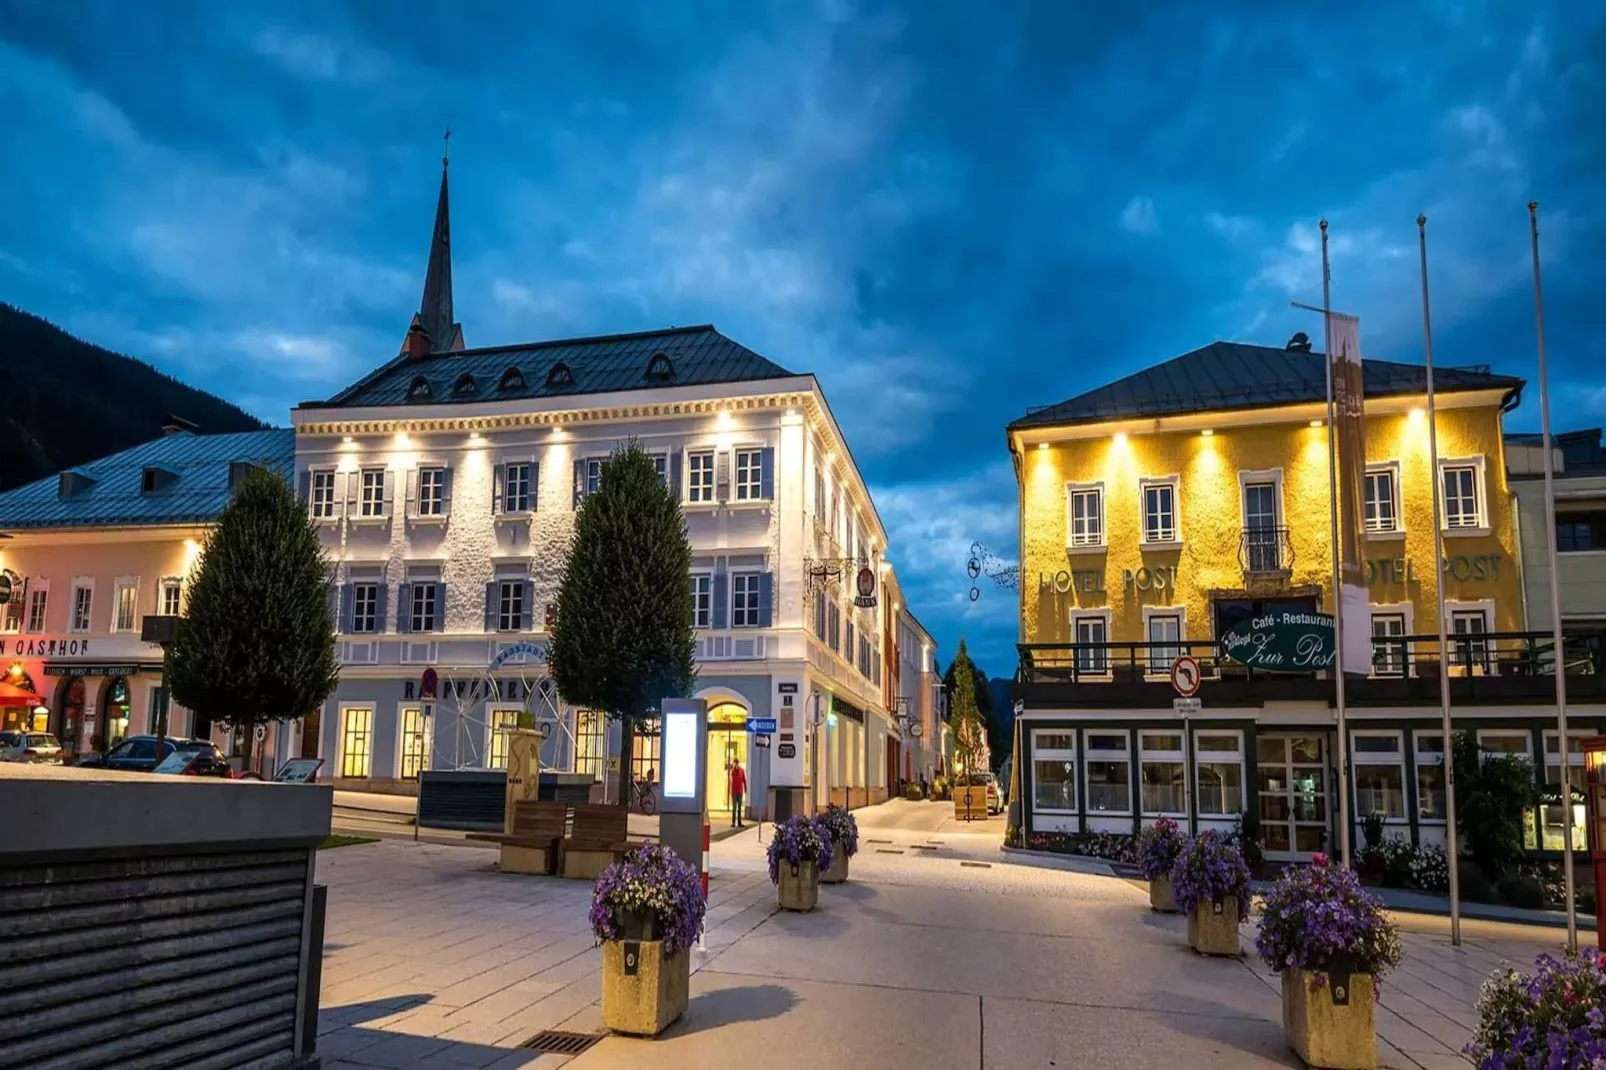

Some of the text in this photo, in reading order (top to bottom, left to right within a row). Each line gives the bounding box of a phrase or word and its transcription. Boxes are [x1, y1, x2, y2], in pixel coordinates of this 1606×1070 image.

[1040, 565, 1177, 593] HOTEL POST
[1252, 614, 1275, 630] Café
[1247, 633, 1285, 665] Zur
